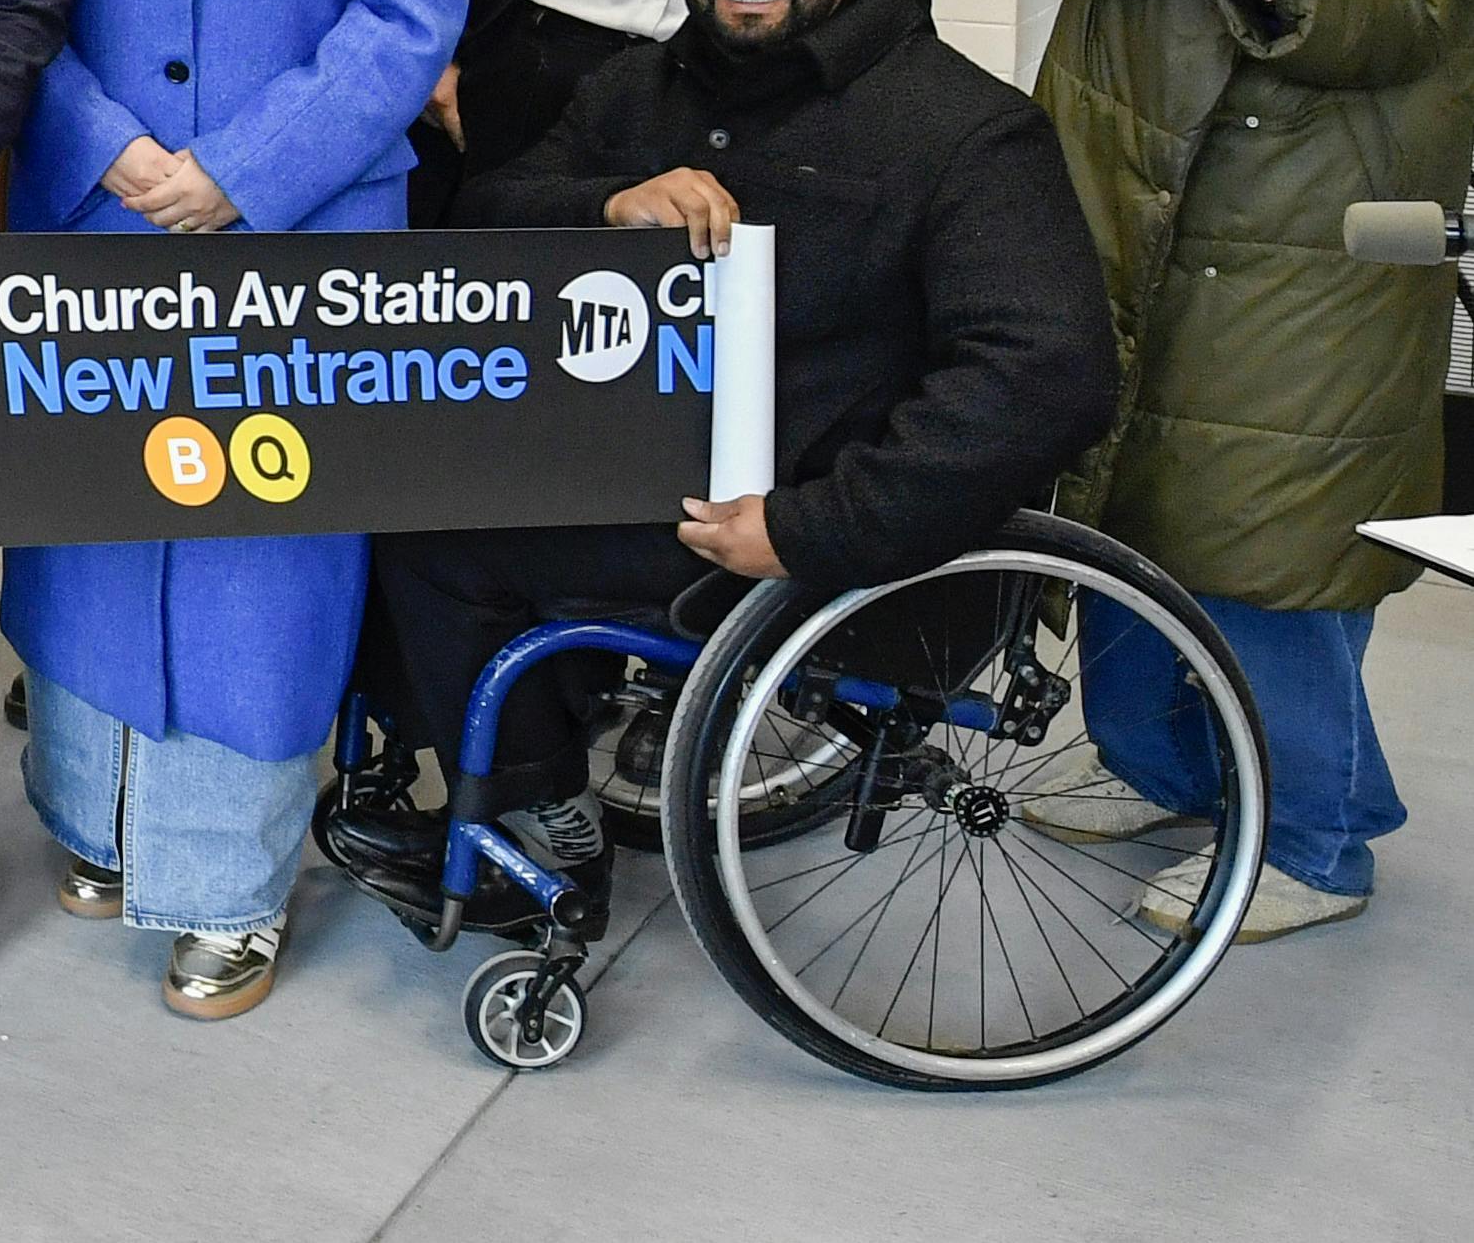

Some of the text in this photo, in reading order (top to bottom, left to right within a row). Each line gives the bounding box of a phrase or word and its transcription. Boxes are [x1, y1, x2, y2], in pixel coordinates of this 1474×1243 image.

[228, 271, 306, 327] Av
[316, 268, 531, 326] Station
[556, 297, 633, 358] MTA
[3, 336, 528, 415] New Entrance
[167, 435, 294, 485] B Q
